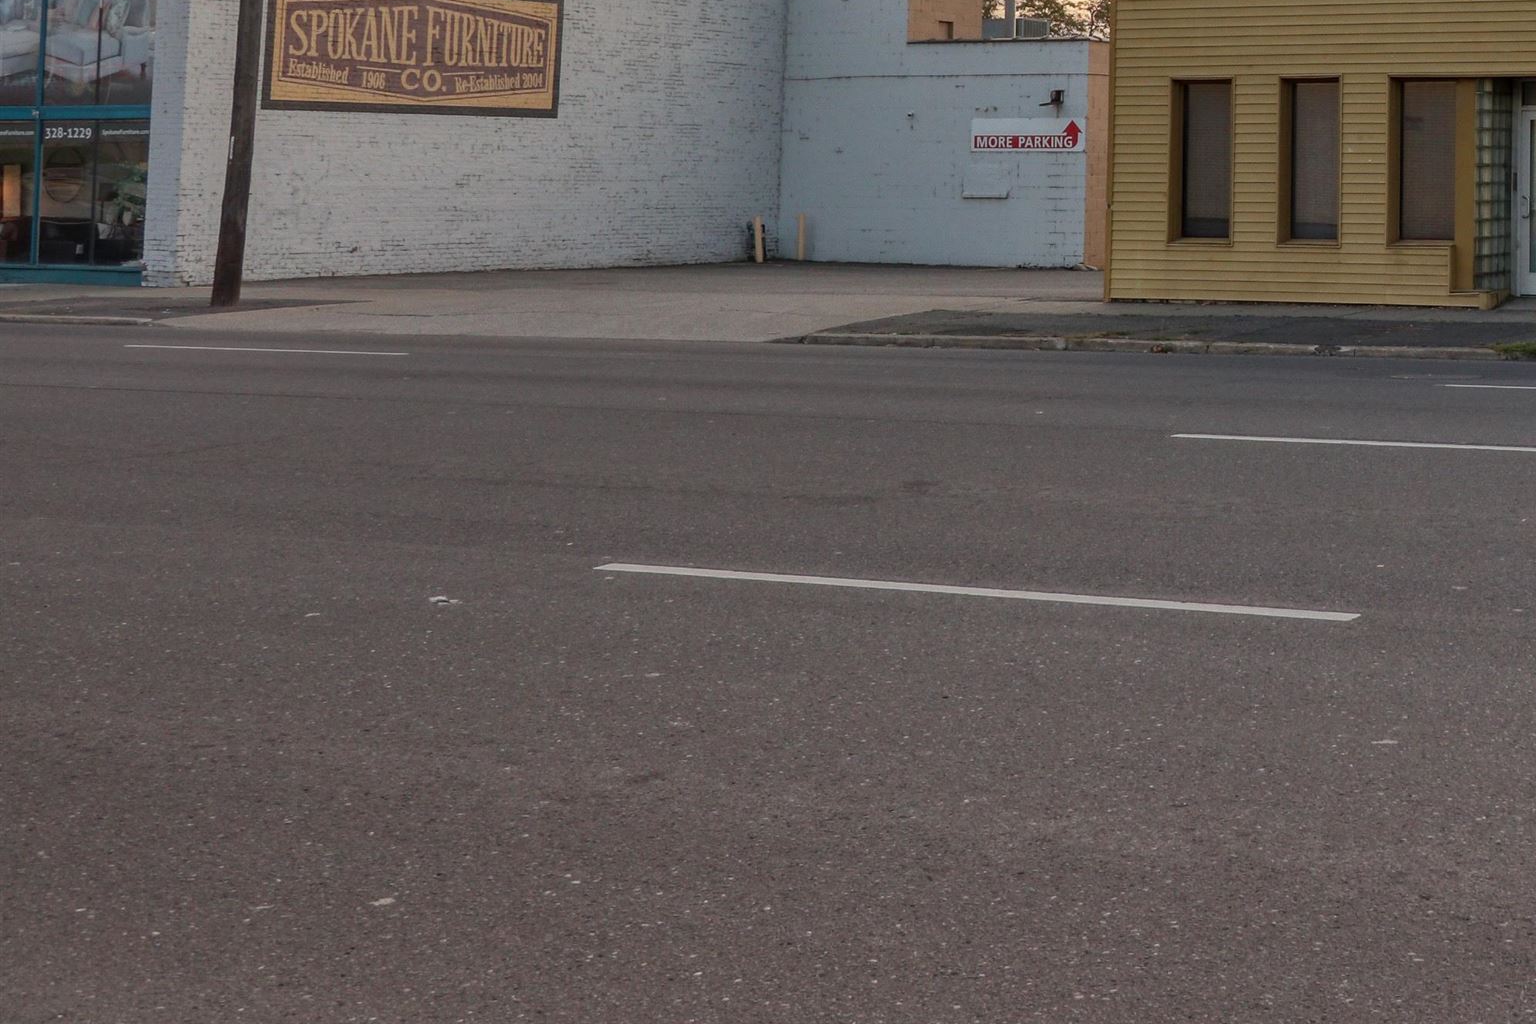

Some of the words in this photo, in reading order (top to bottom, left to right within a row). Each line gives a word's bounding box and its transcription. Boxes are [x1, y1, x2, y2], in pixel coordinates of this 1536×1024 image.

[289, 5, 418, 66] SPOKANE
[422, 5, 545, 68] FURNITURE
[287, 58, 349, 84] Established
[401, 68, 447, 92] CO.
[454, 72, 521, 93] Re-Established
[522, 72, 543, 89] 2004
[45, 127, 92, 139] 328-1229
[976, 136, 1012, 148] MORE
[1018, 136, 1073, 148] PARKING
